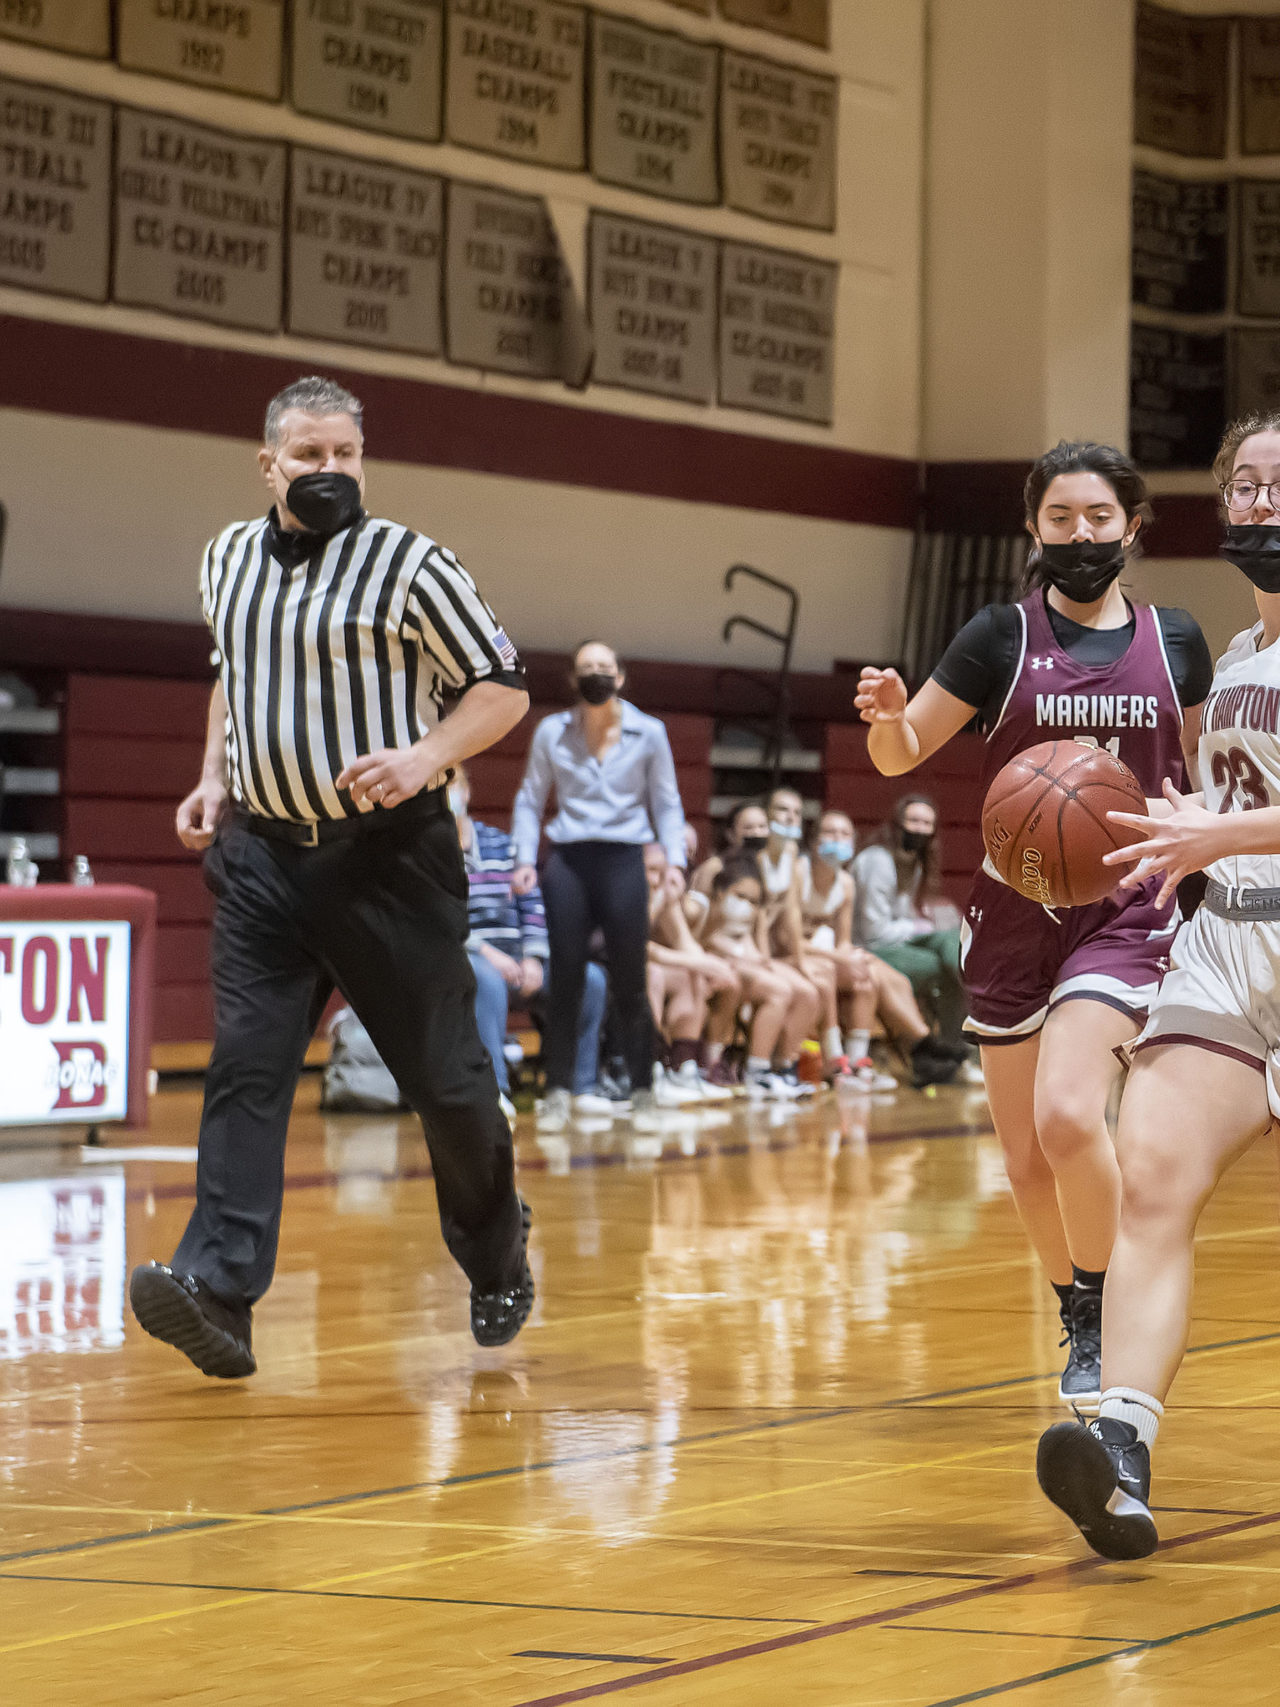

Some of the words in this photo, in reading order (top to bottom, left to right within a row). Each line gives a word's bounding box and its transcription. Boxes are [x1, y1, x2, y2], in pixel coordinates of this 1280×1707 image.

[0, 141, 90, 191] TBALL
[138, 125, 241, 182] LEAGUE
[2, 188, 76, 237] AMPS
[1036, 693, 1158, 729] MARINERS
[1211, 746, 1271, 814] 23
